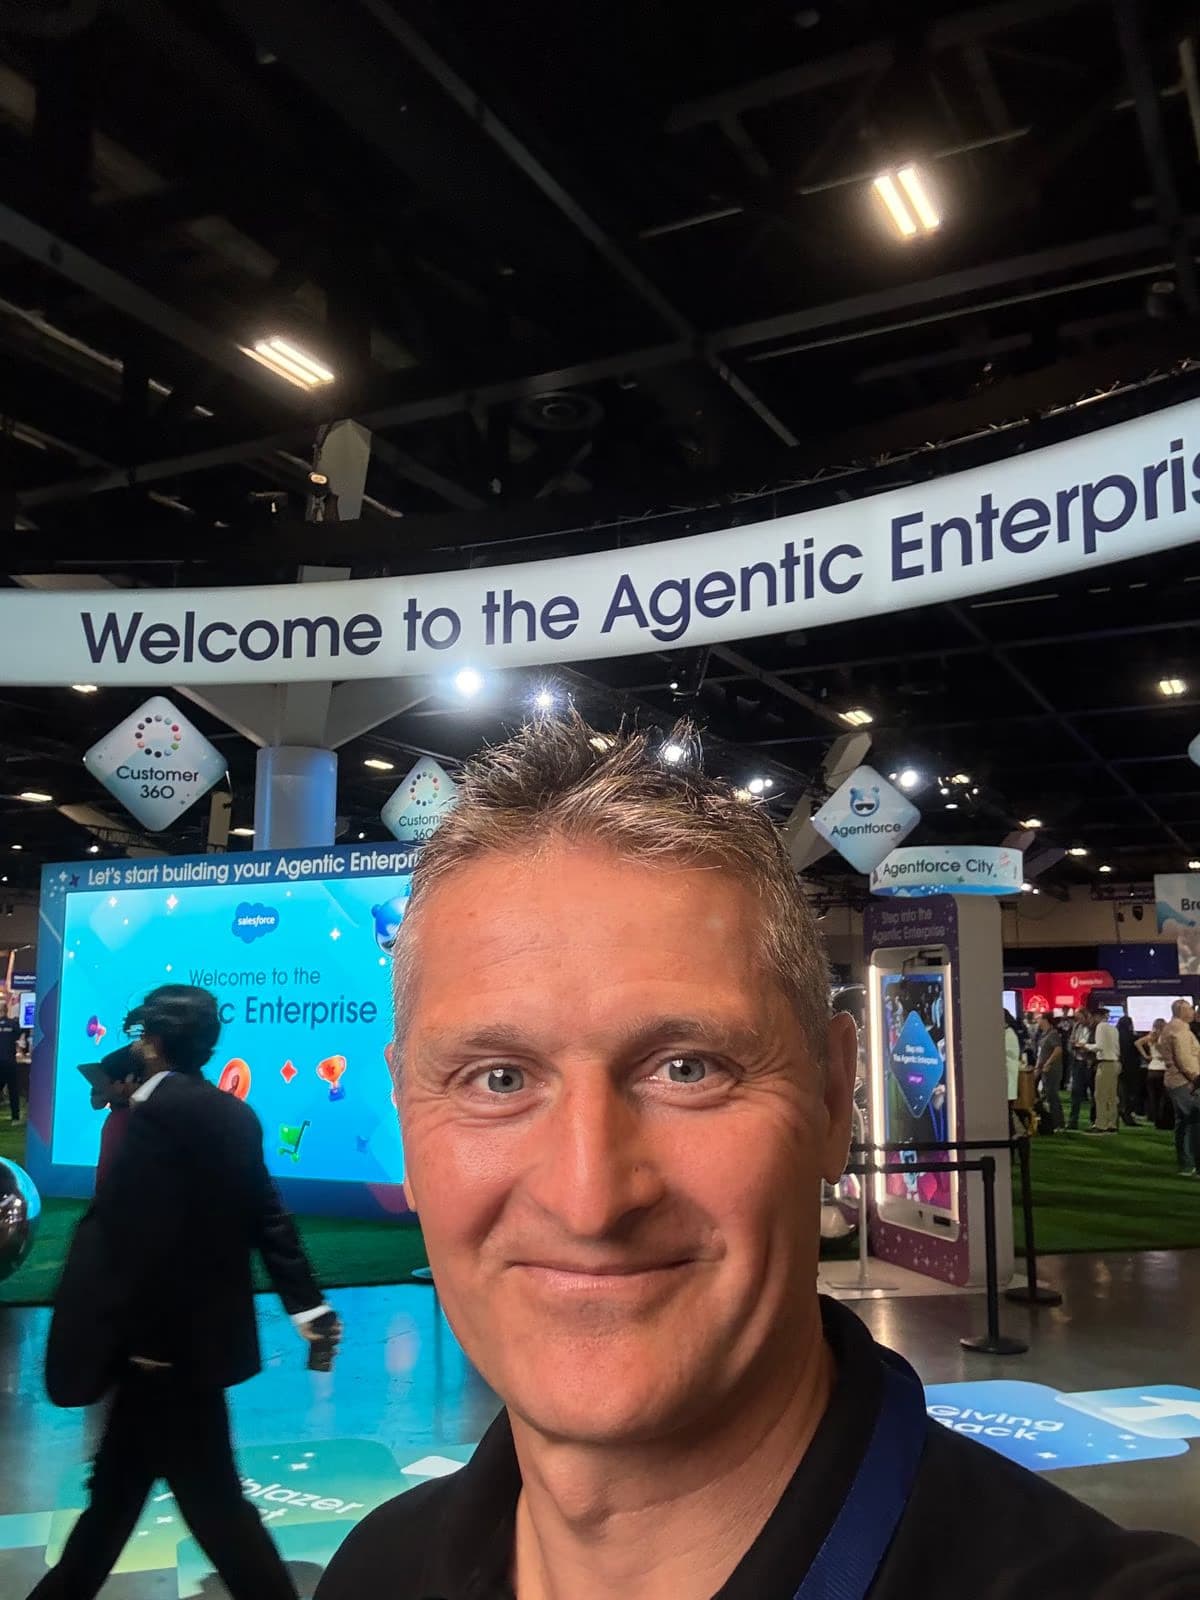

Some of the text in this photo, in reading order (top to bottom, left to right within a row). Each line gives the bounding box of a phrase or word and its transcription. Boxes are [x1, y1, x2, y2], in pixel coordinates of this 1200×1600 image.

[80, 610, 383, 665] Welcome
[403, 597, 462, 652] to
[482, 589, 580, 646] the
[600, 537, 864, 643] Agentic
[116, 765, 200, 782] Customer
[140, 784, 175, 799] 360
[398, 813, 442, 827] Custom
[831, 822, 902, 838] Agentforce
[88, 850, 419, 886] Let's start building your Agentic Enterpri
[883, 859, 961, 878] Agentforce
[965, 858, 995, 876] City
[237, 914, 276, 928] salesforce
[188, 967, 322, 987] Welcome to the
[245, 994, 378, 1030] Enterprise
[926, 1404, 1065, 1432] Giving
[238, 1477, 365, 1514] blazer
